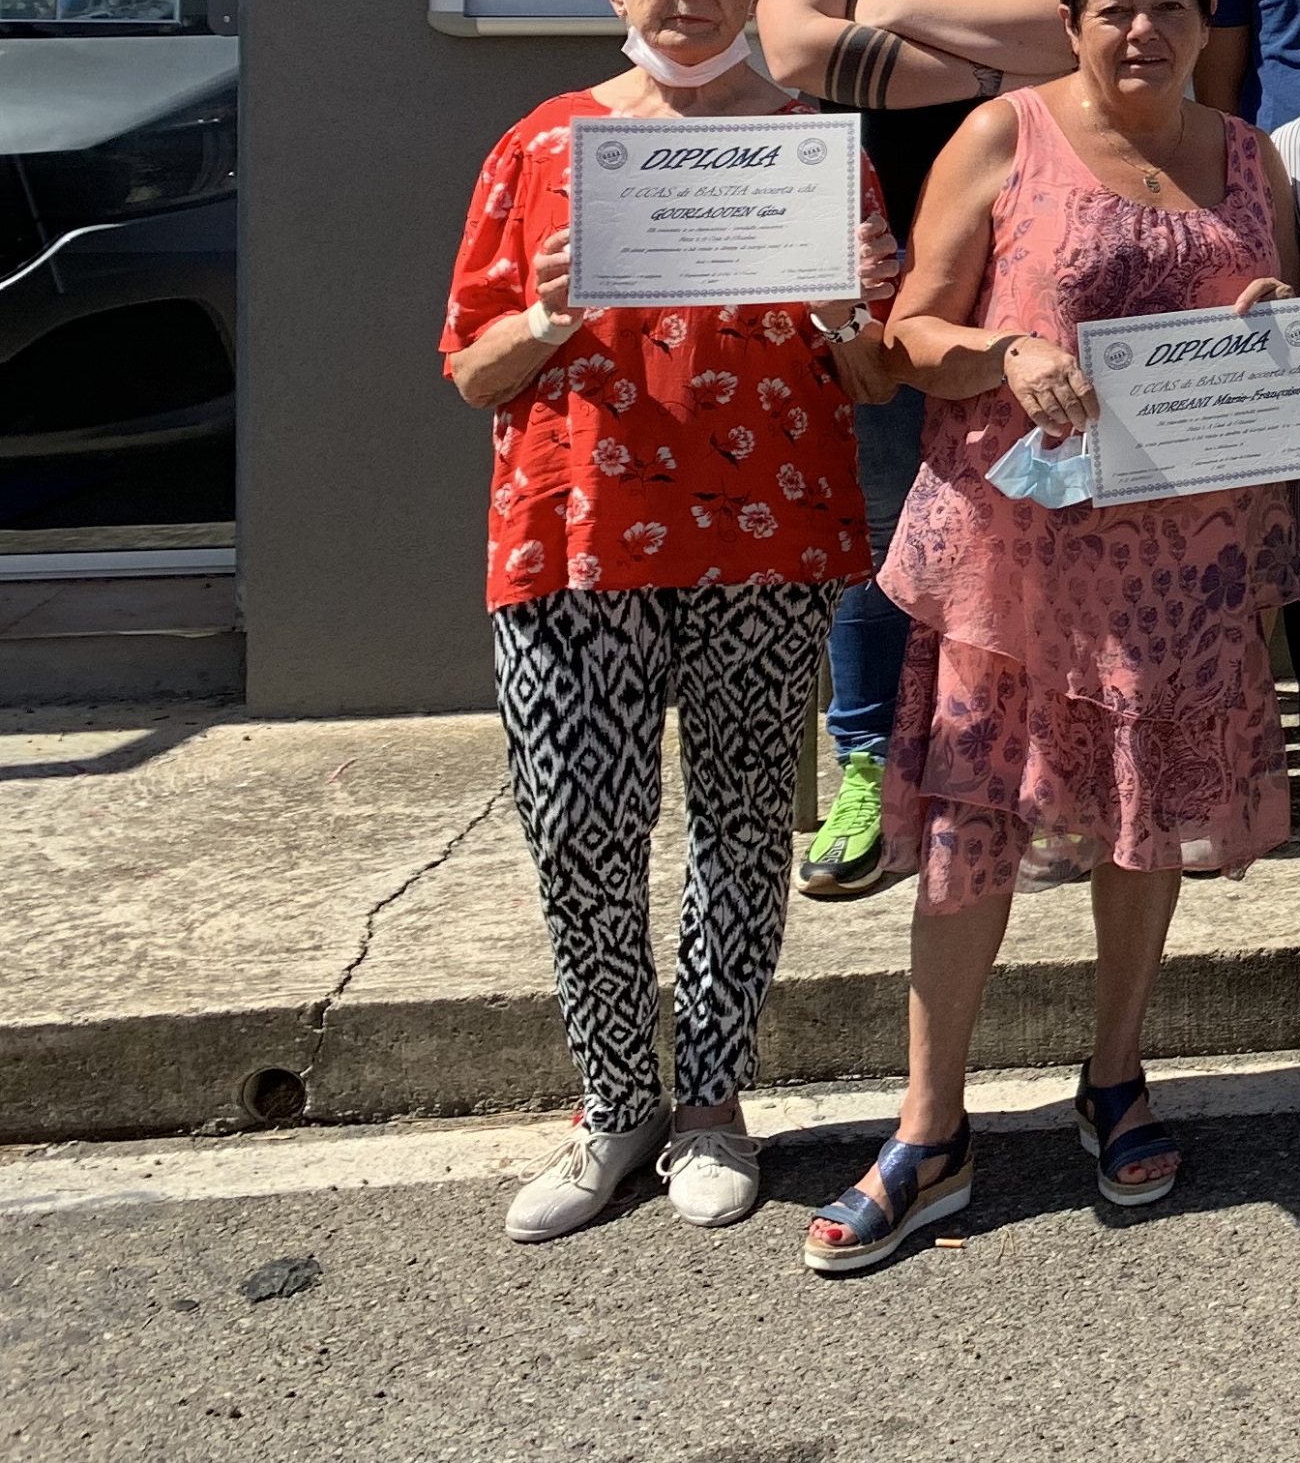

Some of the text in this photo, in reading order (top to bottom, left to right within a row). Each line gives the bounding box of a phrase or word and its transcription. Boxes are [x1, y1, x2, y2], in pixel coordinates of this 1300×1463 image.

[640, 145, 783, 171] DIPLOMA
[634, 187, 674, 199] CCAS
[694, 185, 750, 198] BASTIA
[1145, 329, 1272, 368] DIPLOMA
[1143, 379, 1181, 396] CCAS
[1195, 370, 1247, 388] BASTIA
[1136, 395, 1216, 417] ANDREANI
